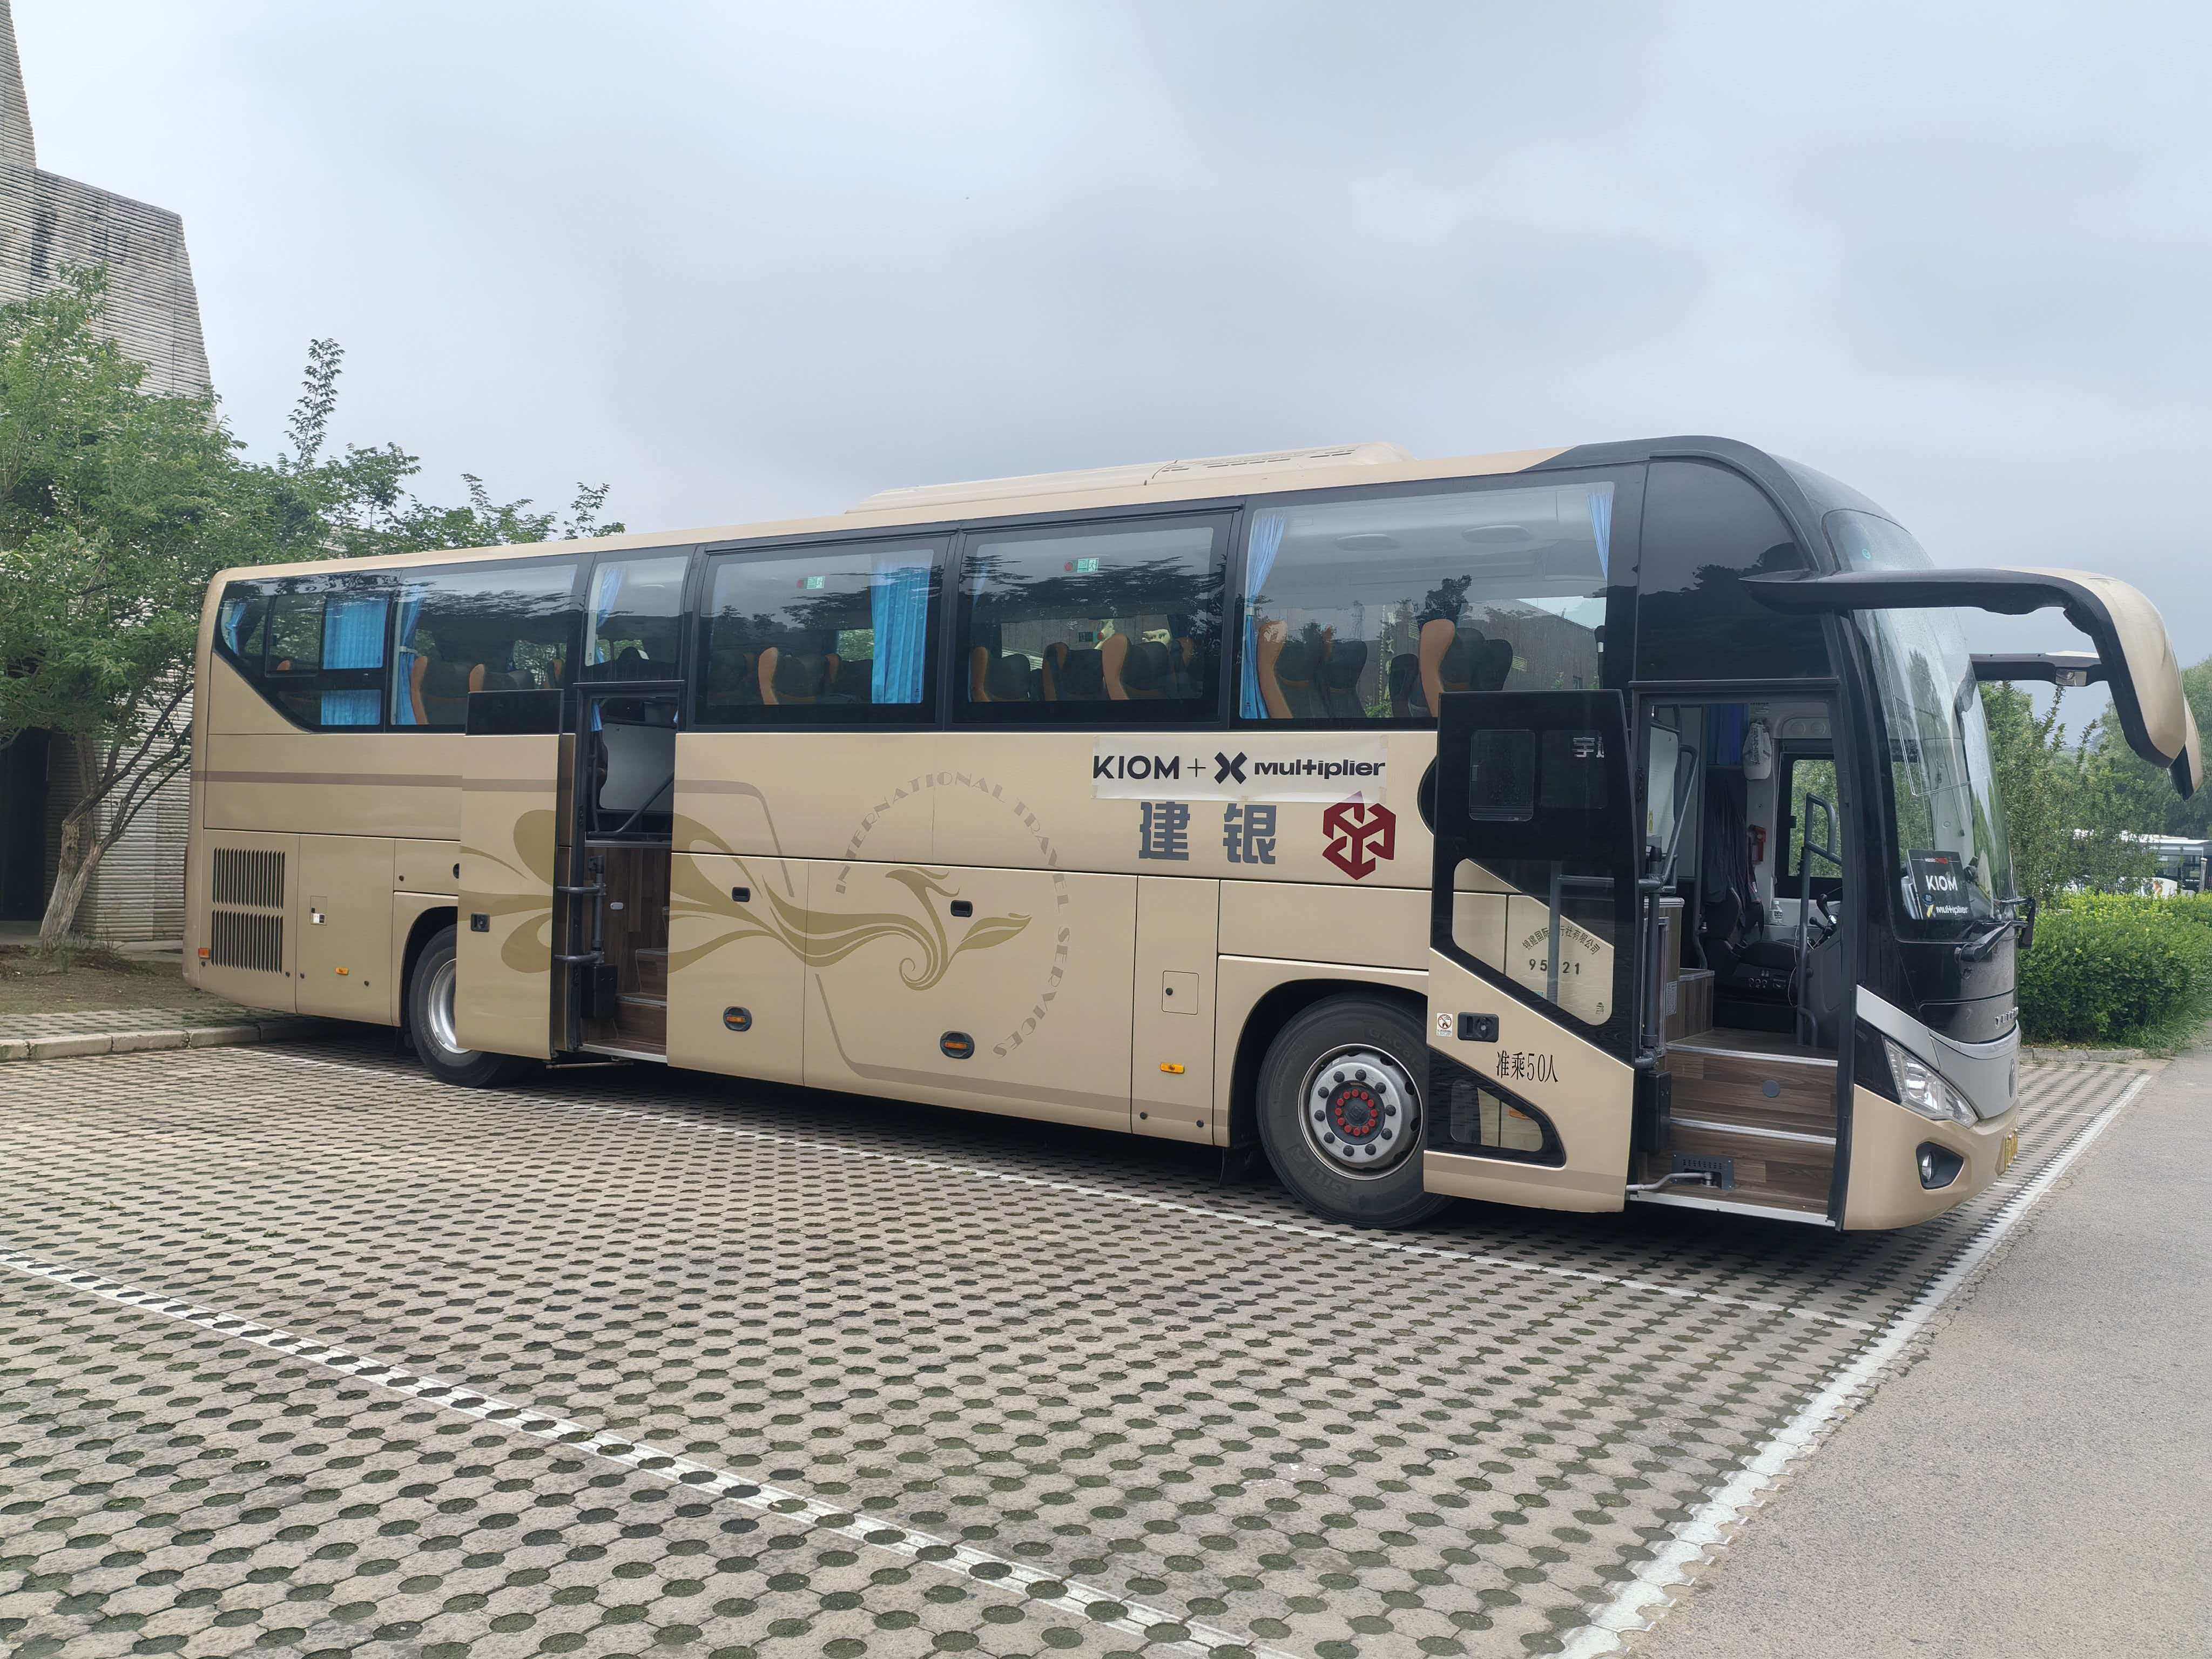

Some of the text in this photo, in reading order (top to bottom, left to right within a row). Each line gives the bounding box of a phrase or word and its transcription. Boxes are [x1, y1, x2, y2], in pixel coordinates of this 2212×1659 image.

[1092, 755, 1179, 779] KIOM
[1138, 801, 1277, 864] 建银
[1925, 875, 1958, 891] KIOM
[835, 771, 1070, 1058] INTERNATIONAL TRAVEL SERVICES
[1496, 1050, 1559, 1083] 准乘50人
